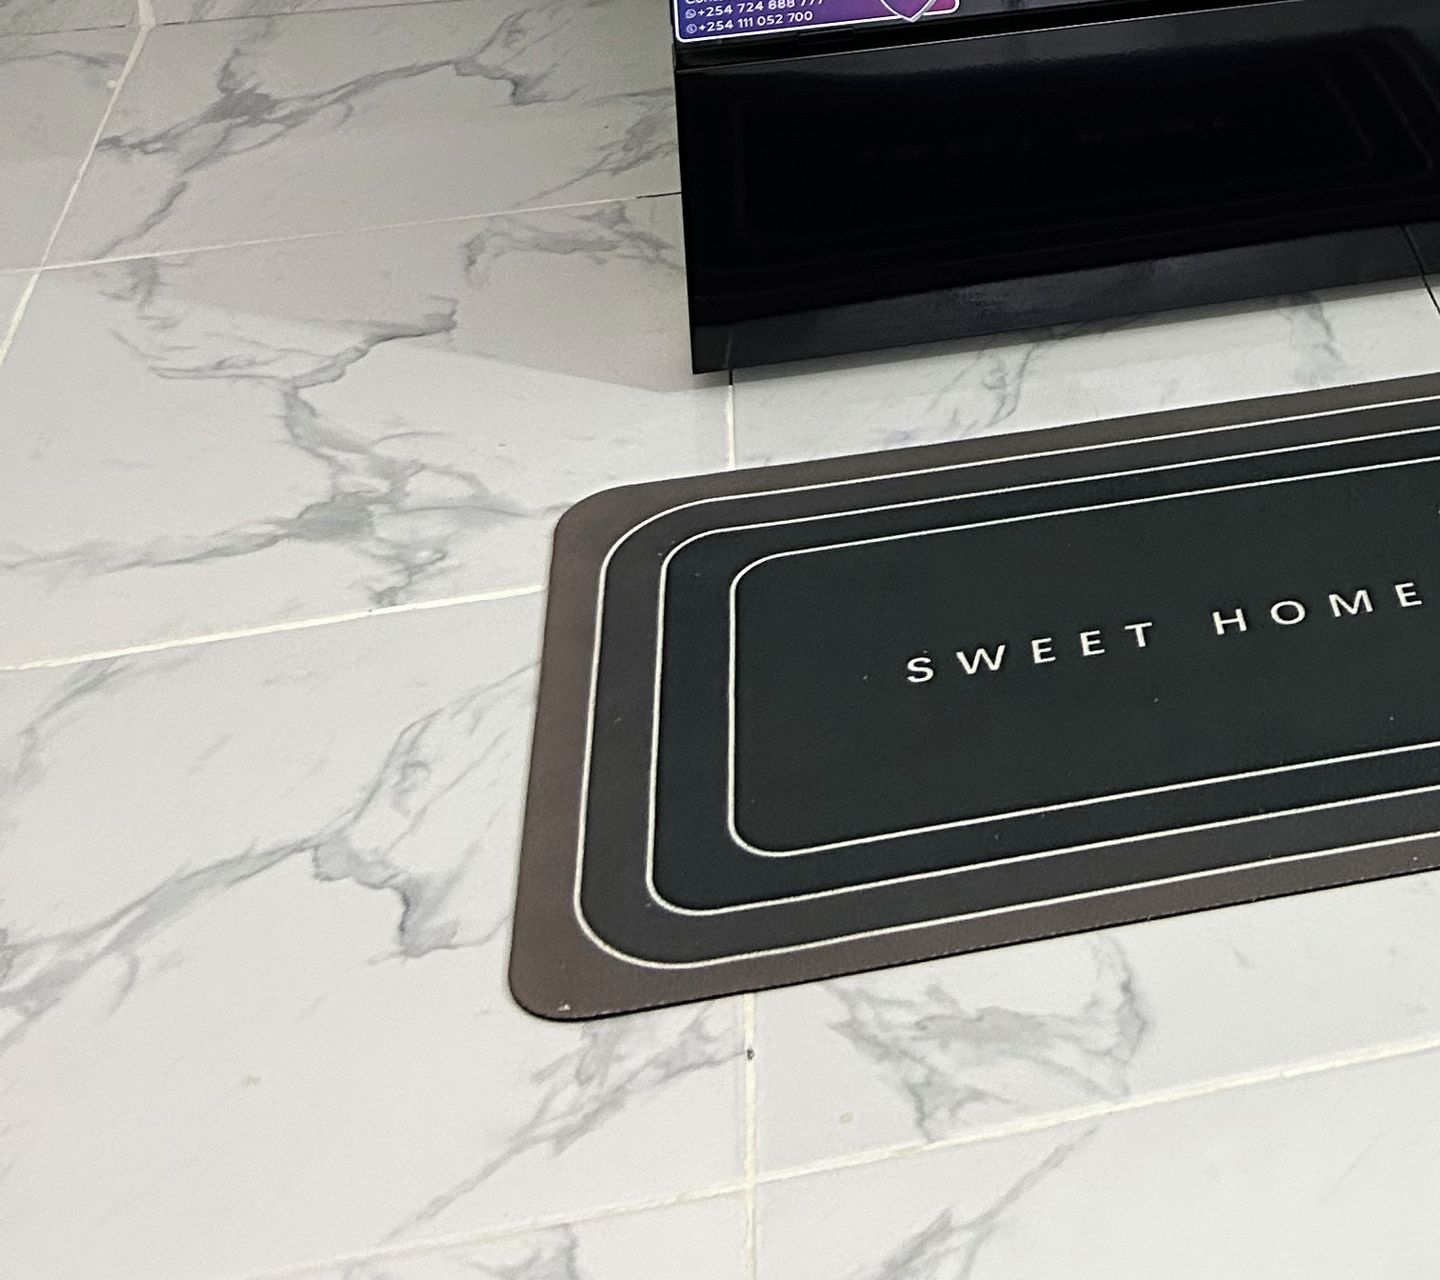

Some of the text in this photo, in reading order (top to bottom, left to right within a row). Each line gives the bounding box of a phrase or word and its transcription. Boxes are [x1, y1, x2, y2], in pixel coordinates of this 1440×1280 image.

[698, 5, 733, 17] +254
[737, 2, 764, 14] 724
[698, 10, 813, 32] +254 111 052 700
[905, 581, 1423, 684] SWEET HOME
